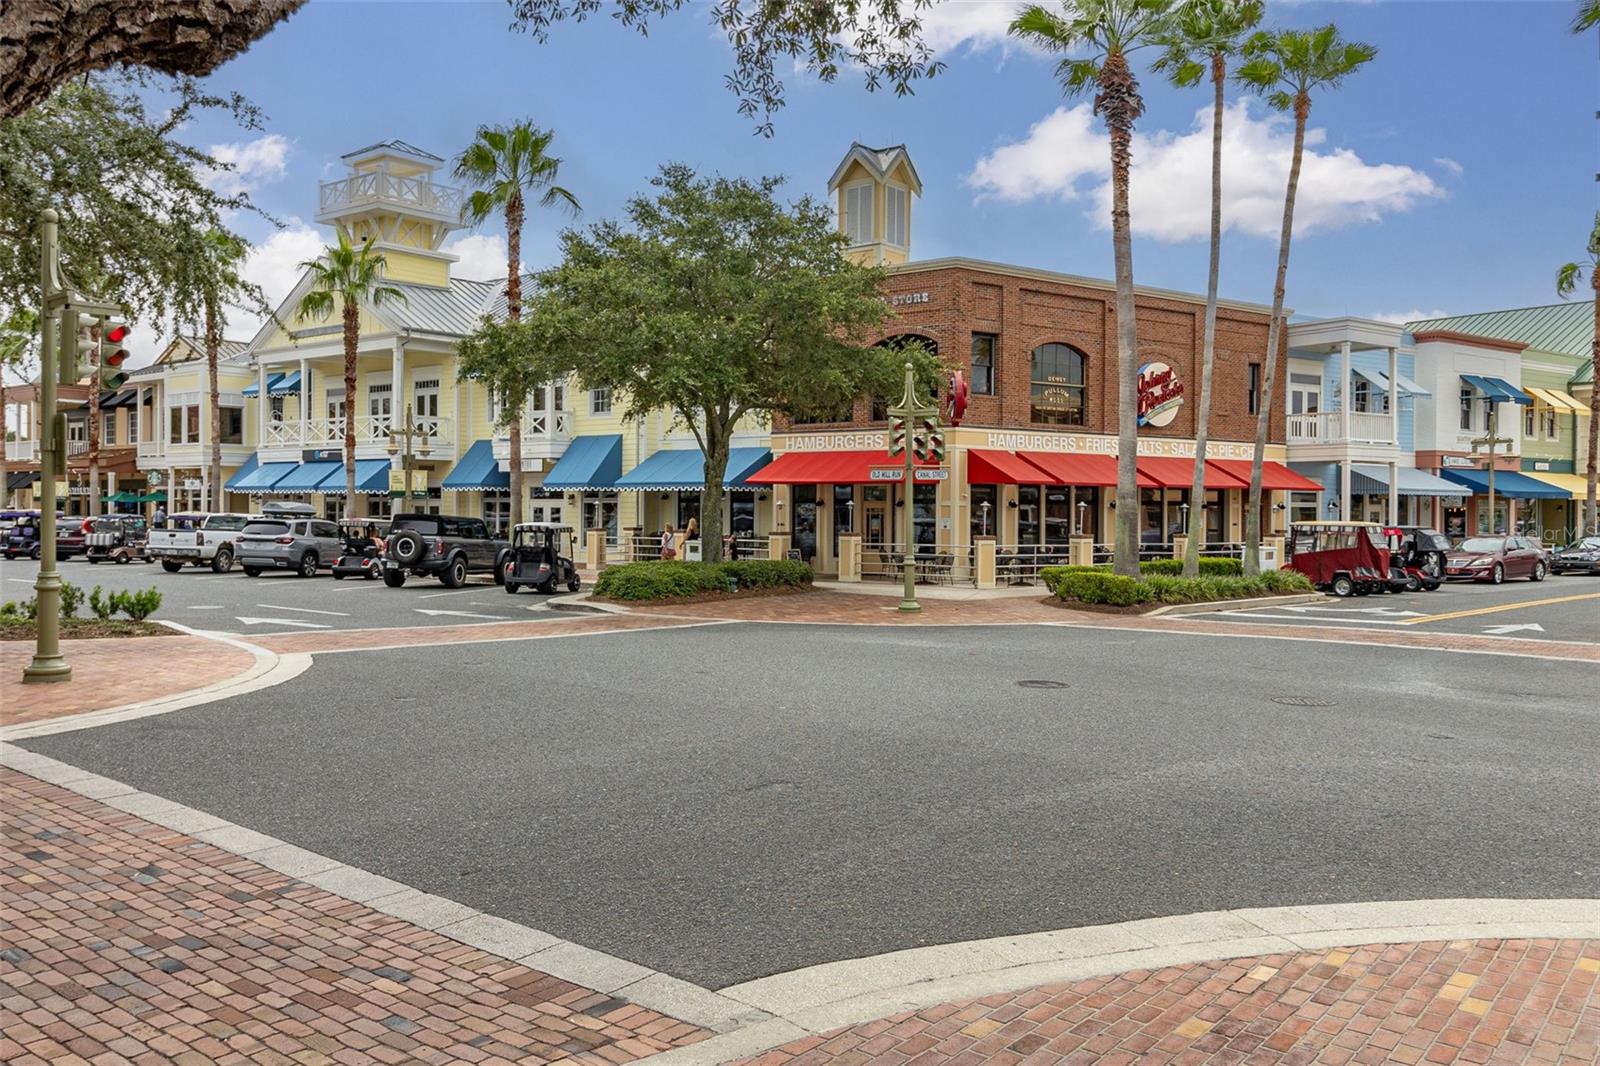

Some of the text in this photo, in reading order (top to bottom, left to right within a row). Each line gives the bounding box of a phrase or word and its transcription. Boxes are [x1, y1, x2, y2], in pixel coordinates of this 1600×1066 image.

[785, 434, 884, 450] HAMBURGERS
[988, 433, 1076, 450] HAMBURGERS
[1086, 438, 1119, 452] FRIES
[1136, 440, 1162, 454] ALTS
[1171, 442, 1213, 456] SALAS
[1219, 446, 1233, 457] PIE
[917, 470, 946, 478] CANAL STREET
